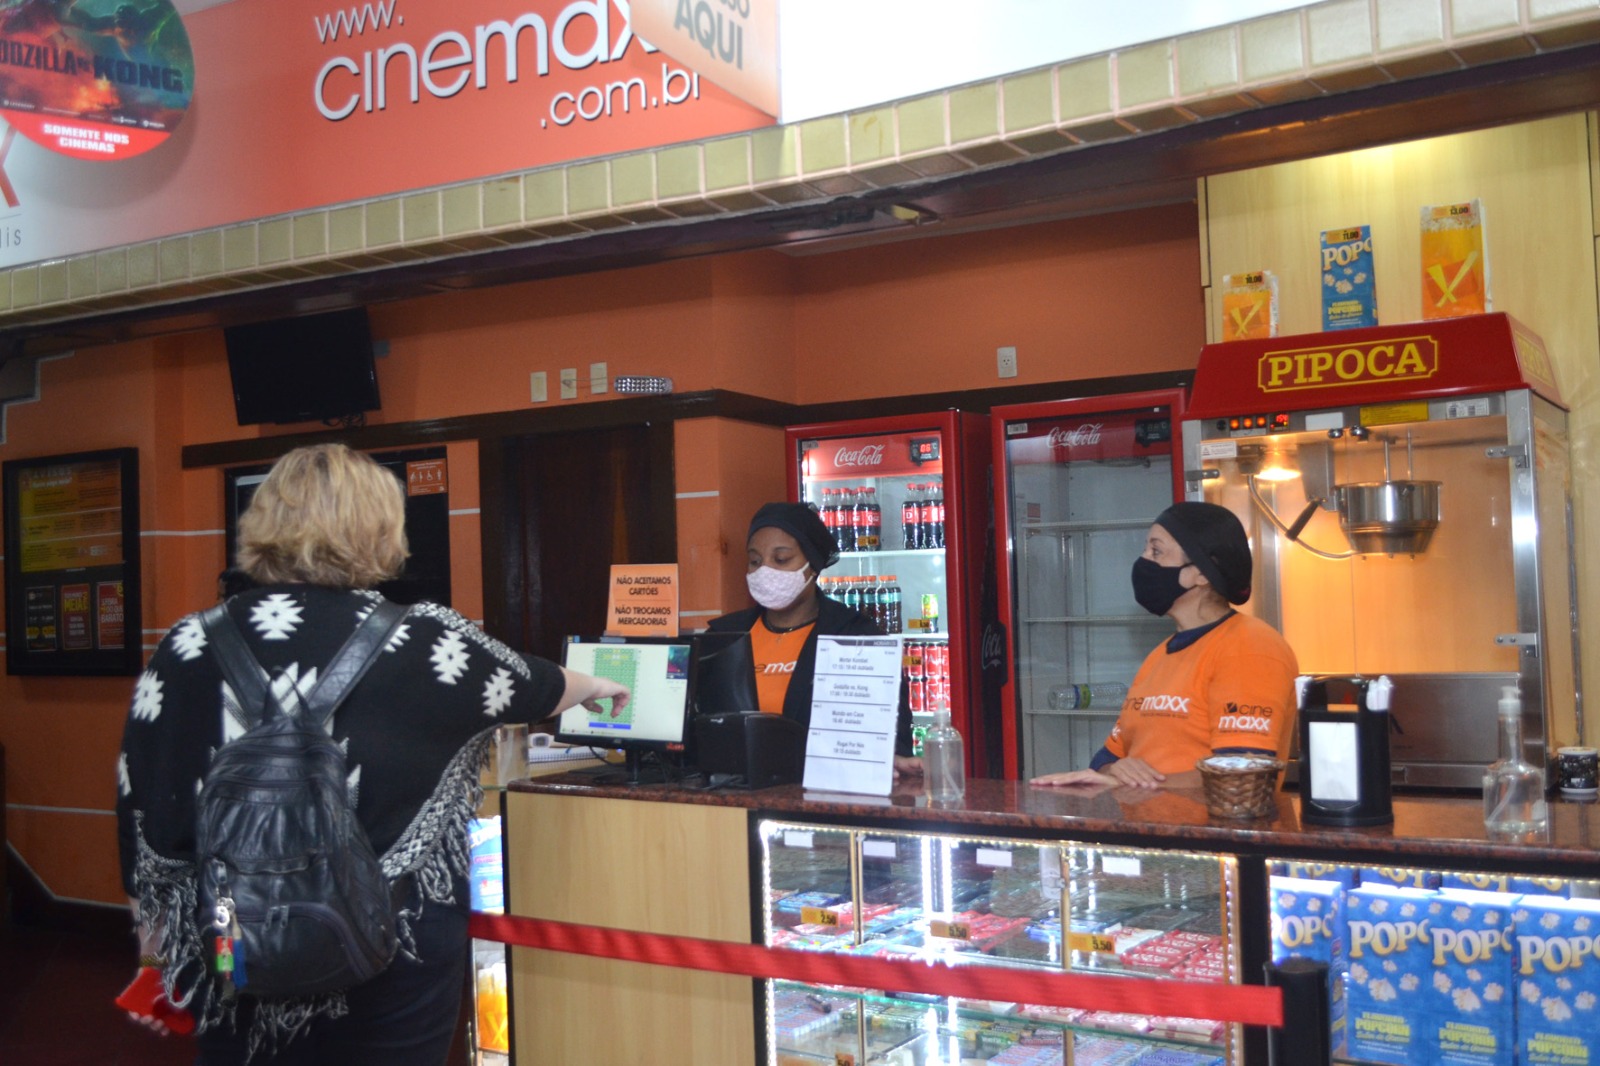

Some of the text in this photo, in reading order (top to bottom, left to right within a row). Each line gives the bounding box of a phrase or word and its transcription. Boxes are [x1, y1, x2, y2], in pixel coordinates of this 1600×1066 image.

[315, 0, 403, 43] www.
[673, 0, 743, 70] AQUI
[94, 55, 184, 93] KONG
[43, 123, 130, 145] SOMENTE NOS
[59, 136, 116, 153] CINEMAS
[1268, 343, 1427, 386] PIPOCA
[834, 445, 885, 467] Coca-Cola
[616, 575, 671, 585] NÃO ACEITAMOS
[629, 586, 659, 595] CARTÕES
[615, 605, 671, 615] NÃO TROCAMOS
[617, 617, 667, 626] MERCADORIAS
[1238, 704, 1273, 718] cine
[1218, 715, 1270, 731] maxx
